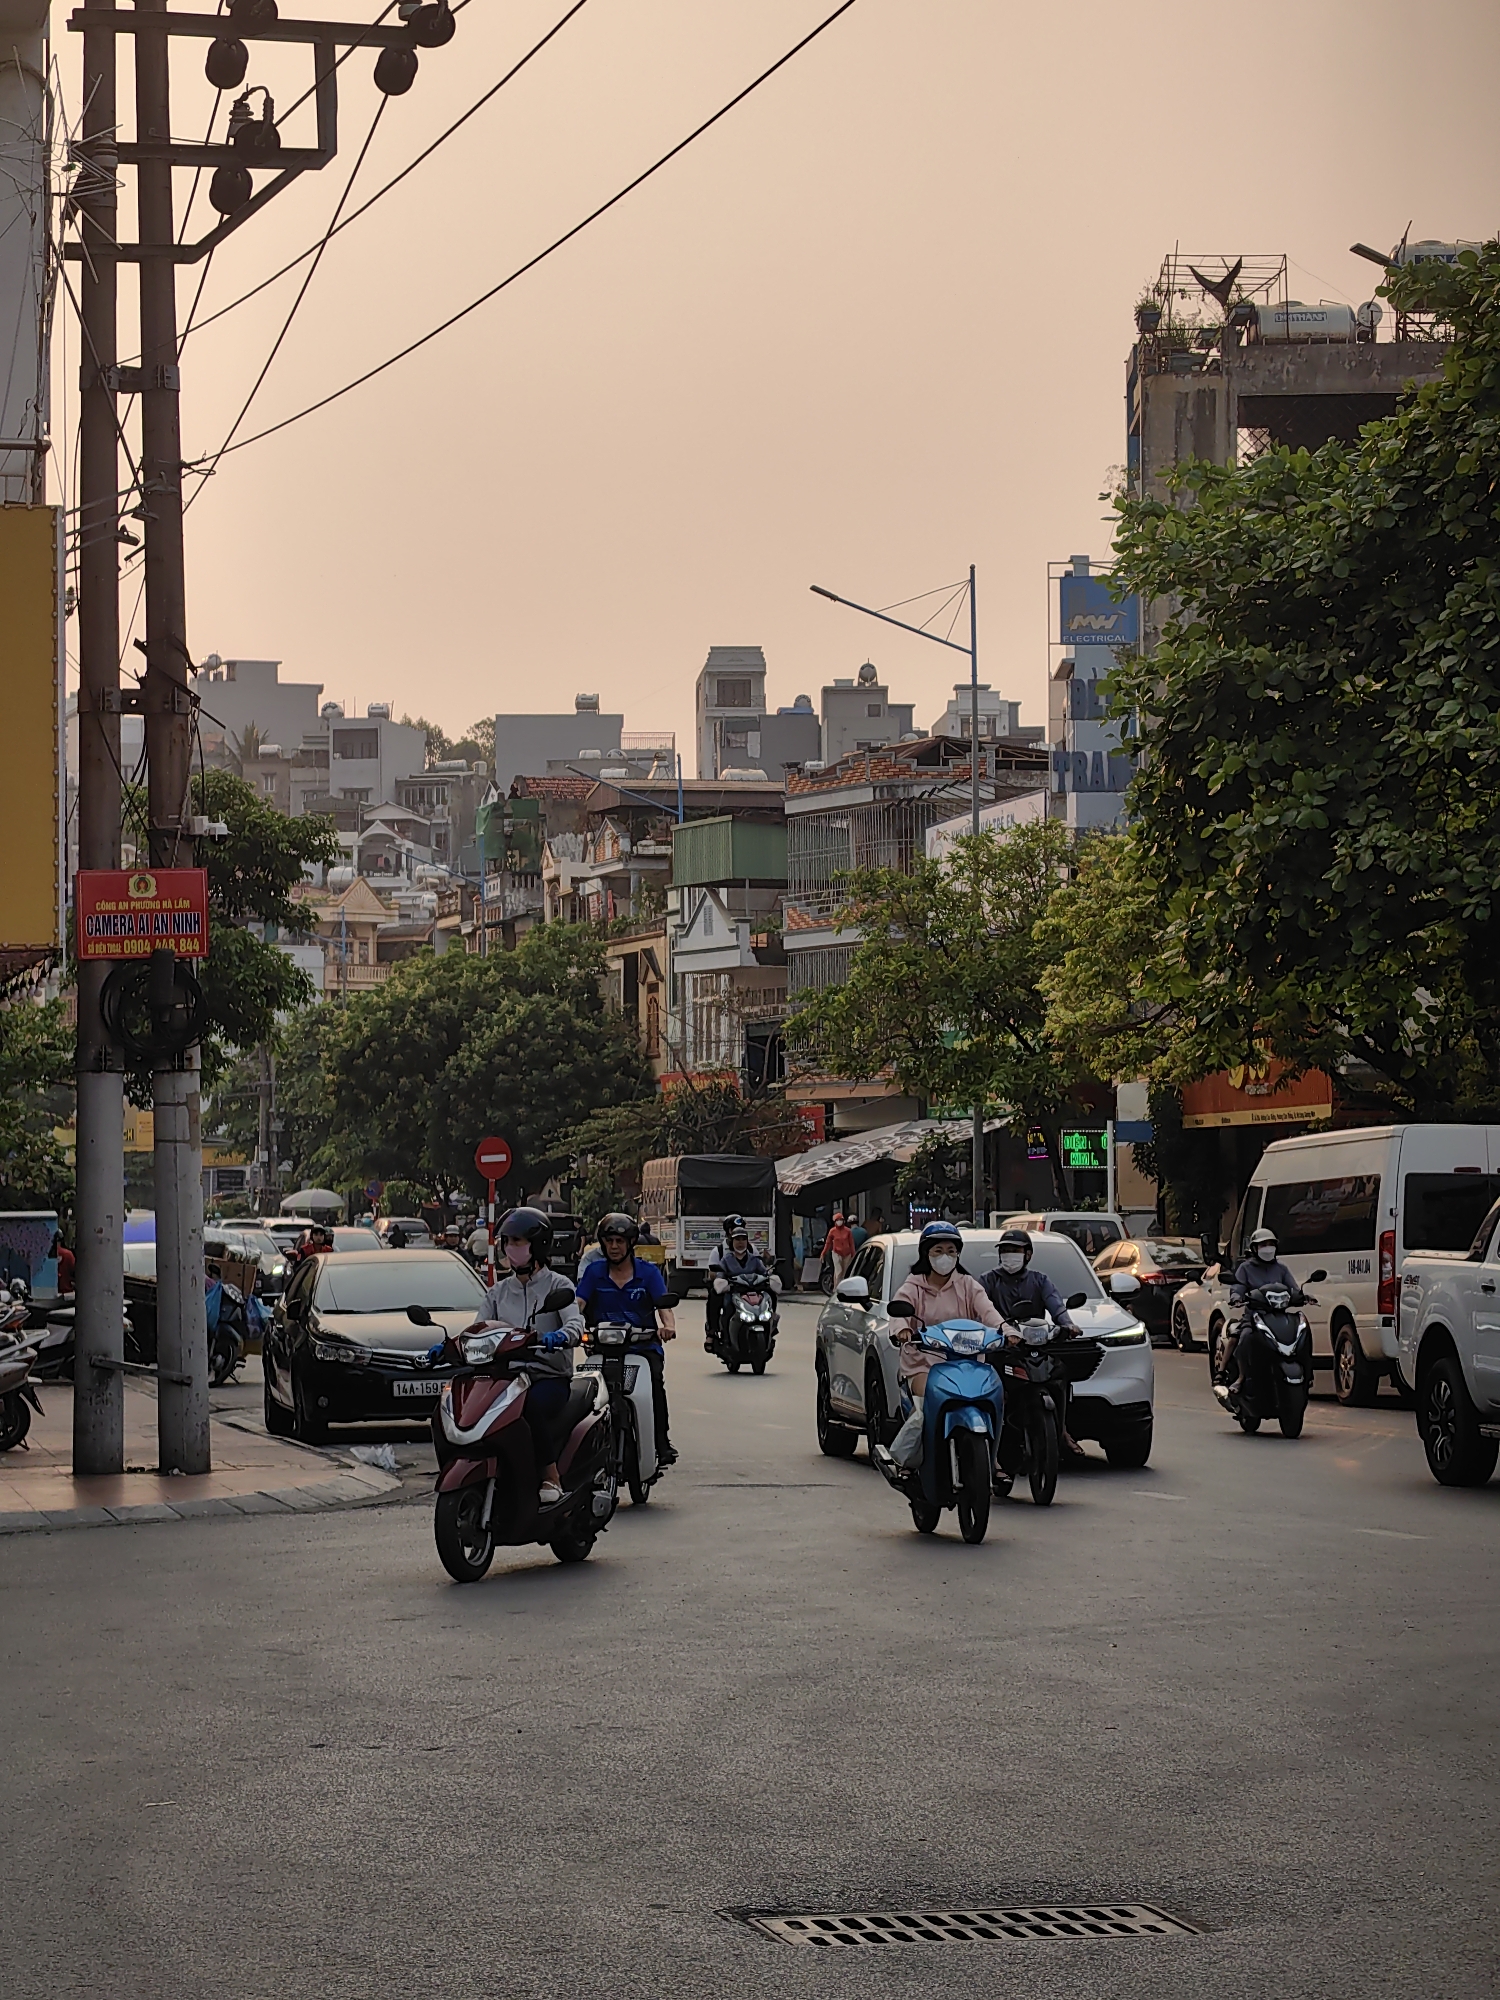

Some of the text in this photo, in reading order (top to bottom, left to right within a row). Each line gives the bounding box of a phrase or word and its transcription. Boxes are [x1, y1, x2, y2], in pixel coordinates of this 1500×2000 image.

[95, 899, 116, 911] CÔNG
[118, 901, 129, 910] AN
[162, 898, 173, 909] HÀ
[86, 911, 201, 937] CAMERA AI AN NINH
